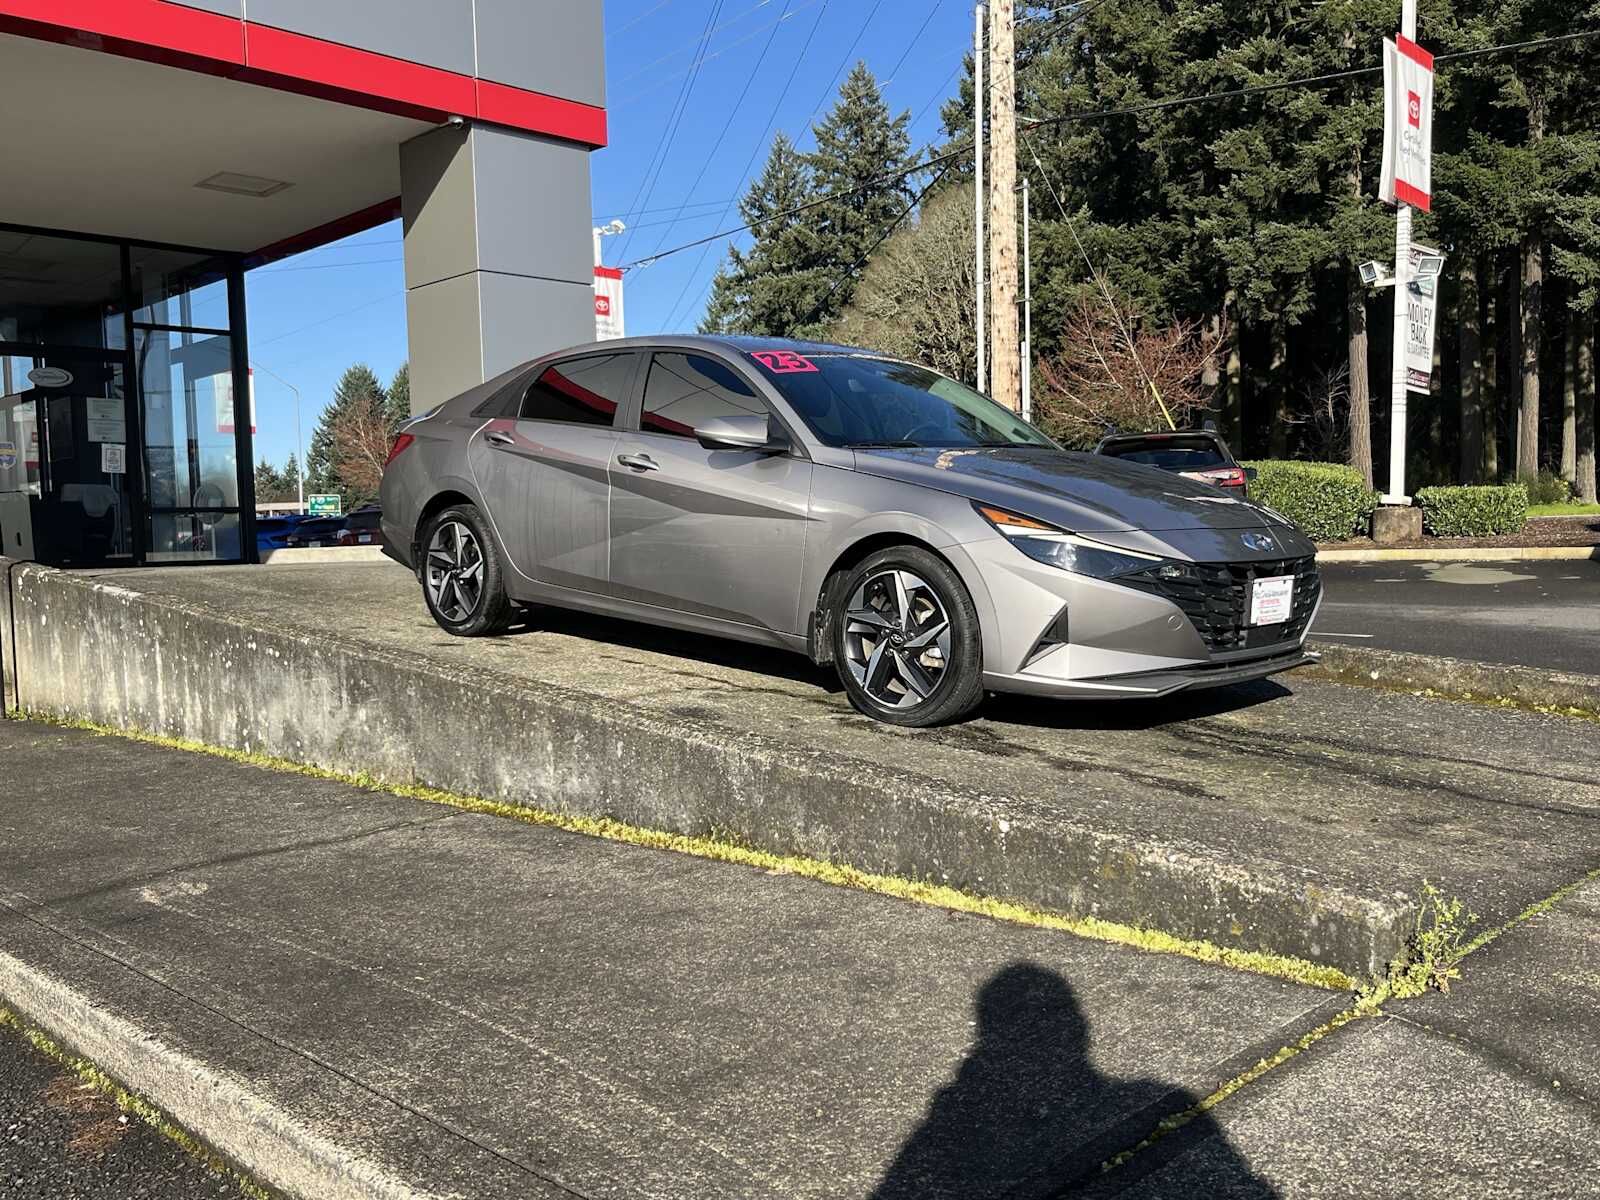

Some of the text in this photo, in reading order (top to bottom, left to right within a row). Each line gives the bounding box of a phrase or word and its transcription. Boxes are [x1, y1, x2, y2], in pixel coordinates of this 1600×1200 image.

[1408, 303, 1432, 328] MONEY
[1410, 323, 1427, 345] BACK
[760, 353, 808, 369] 23
